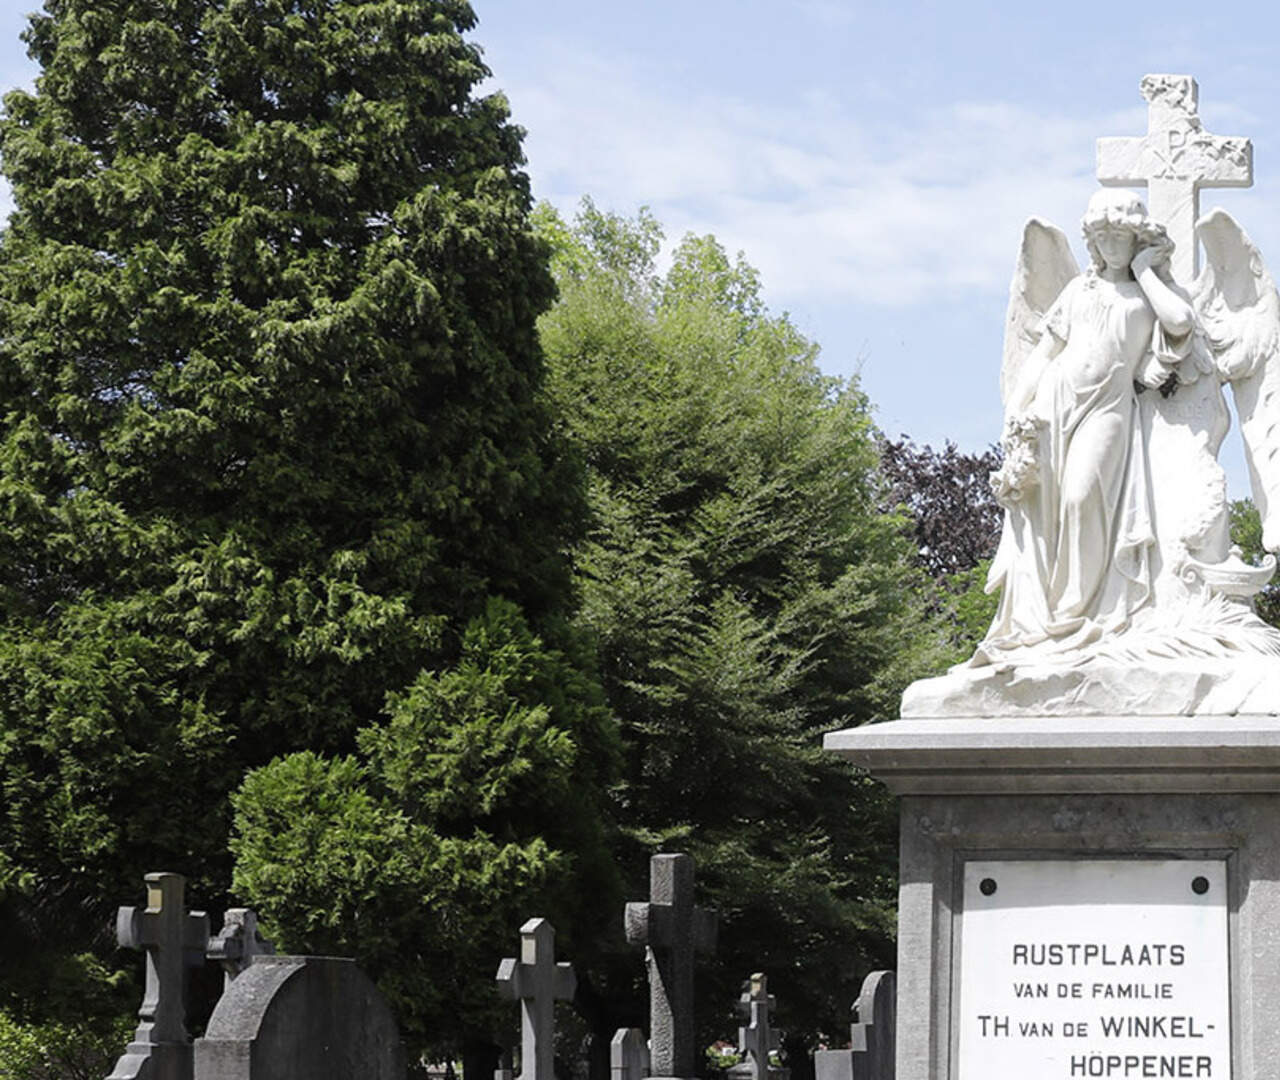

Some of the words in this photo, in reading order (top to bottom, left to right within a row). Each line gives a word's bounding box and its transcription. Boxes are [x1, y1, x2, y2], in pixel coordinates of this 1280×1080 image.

[1012, 944, 1185, 966] RUSTPLAATS
[1013, 983, 1049, 999] VAN
[1057, 983, 1083, 999] DE
[1092, 983, 1173, 999] FAMILIE
[1018, 1022, 1054, 1038] VAN
[1063, 1022, 1088, 1038] DE
[1100, 1016, 1216, 1038] WINKEL-
